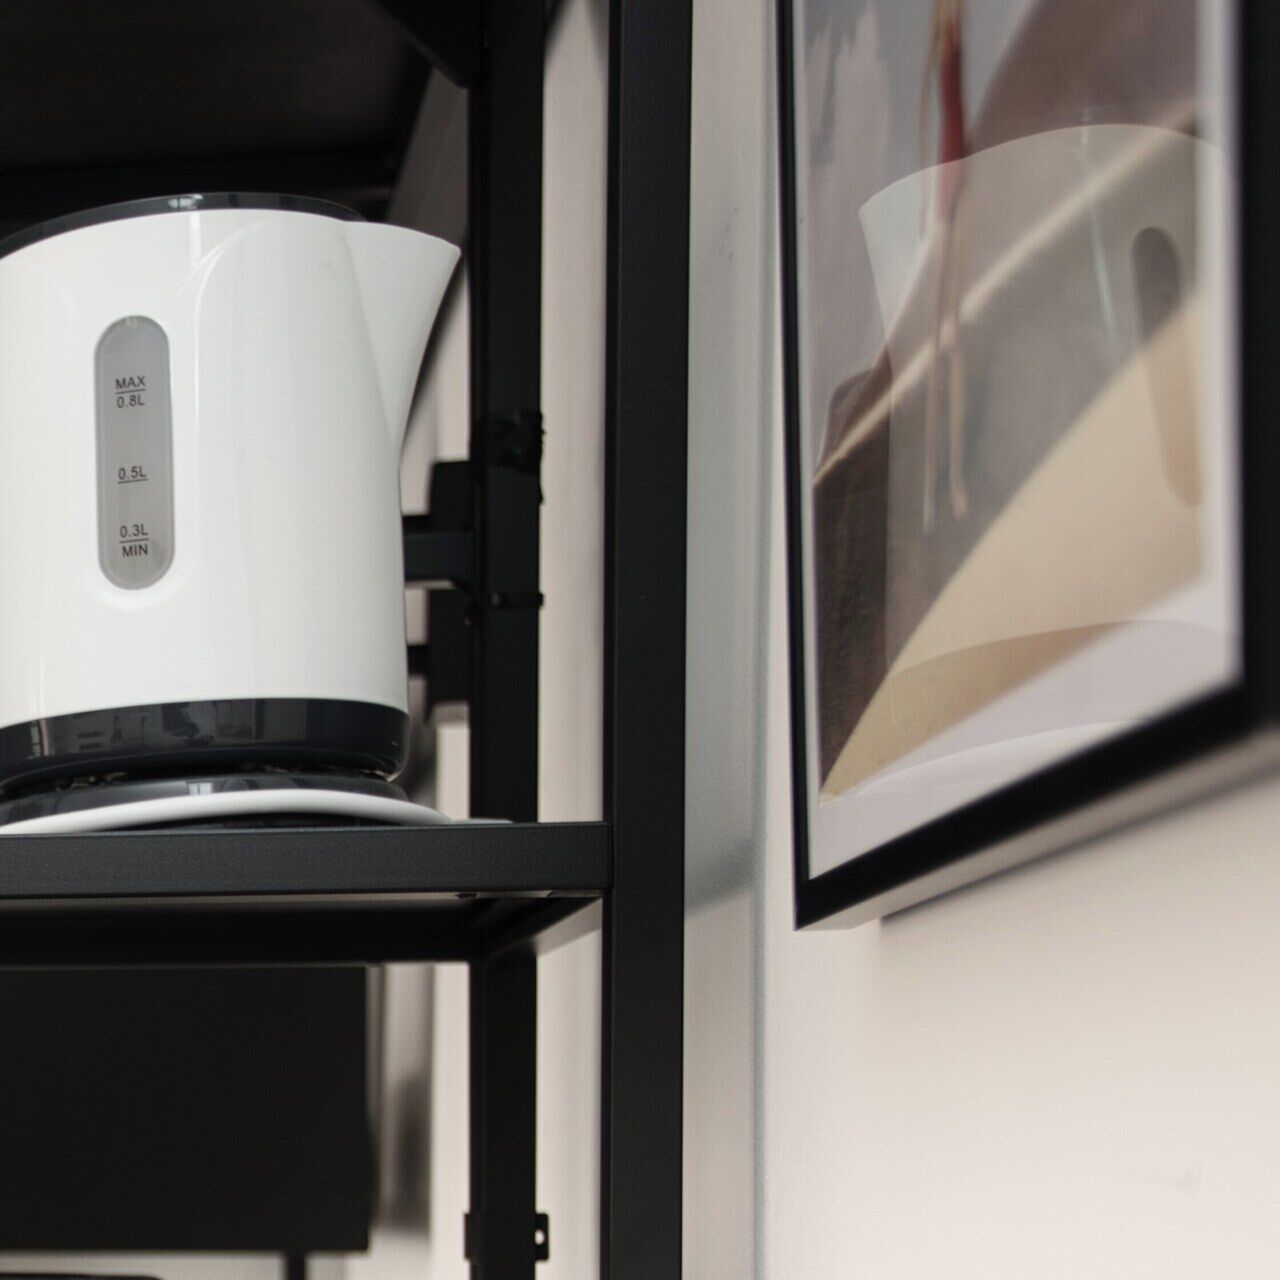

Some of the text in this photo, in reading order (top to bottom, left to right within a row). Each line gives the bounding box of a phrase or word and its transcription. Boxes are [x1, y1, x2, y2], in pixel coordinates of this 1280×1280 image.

[115, 376, 146, 390] MAX
[116, 395, 145, 409] 0.8L
[118, 466, 147, 480] 0.5L
[119, 525, 148, 538] 0.3L
[122, 545, 148, 557] MIN
